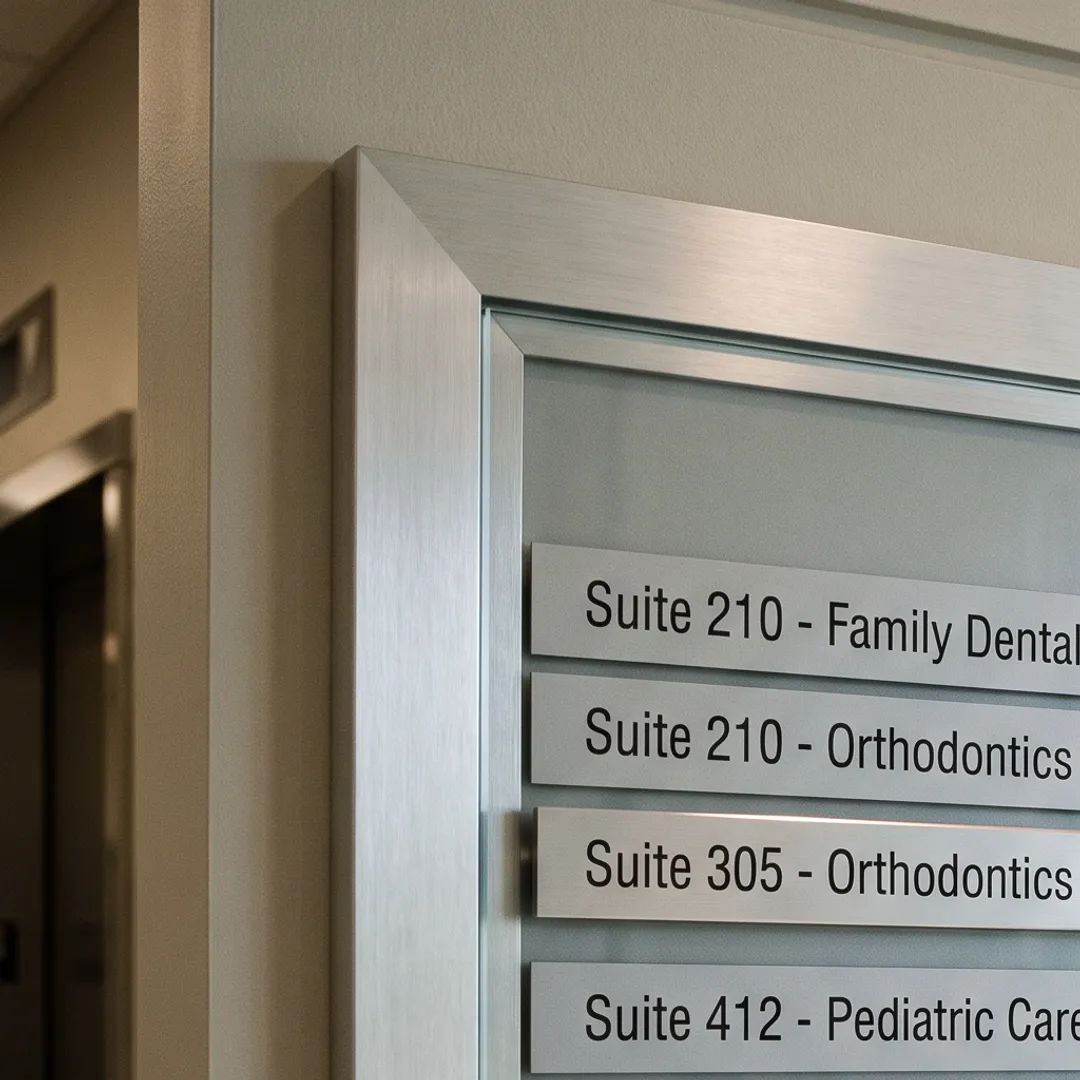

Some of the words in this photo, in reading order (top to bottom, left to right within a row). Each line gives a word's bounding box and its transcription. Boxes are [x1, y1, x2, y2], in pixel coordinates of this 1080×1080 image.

[586, 579, 692, 634] Suite
[707, 590, 783, 642] 210
[797, 621, 813, 629] -
[829, 601, 953, 665] Family
[967, 613, 1080, 666] Dental
[585, 706, 691, 760] Suite
[707, 715, 783, 765] 210
[797, 743, 812, 751] -
[827, 722, 1072, 781] Orthodontics
[586, 838, 691, 890] Suite
[707, 844, 783, 893] 305
[828, 848, 1073, 901] Orthodontics
[585, 993, 691, 1042] Suite
[705, 995, 782, 1041] 412
[828, 996, 994, 1042] Pediatric
